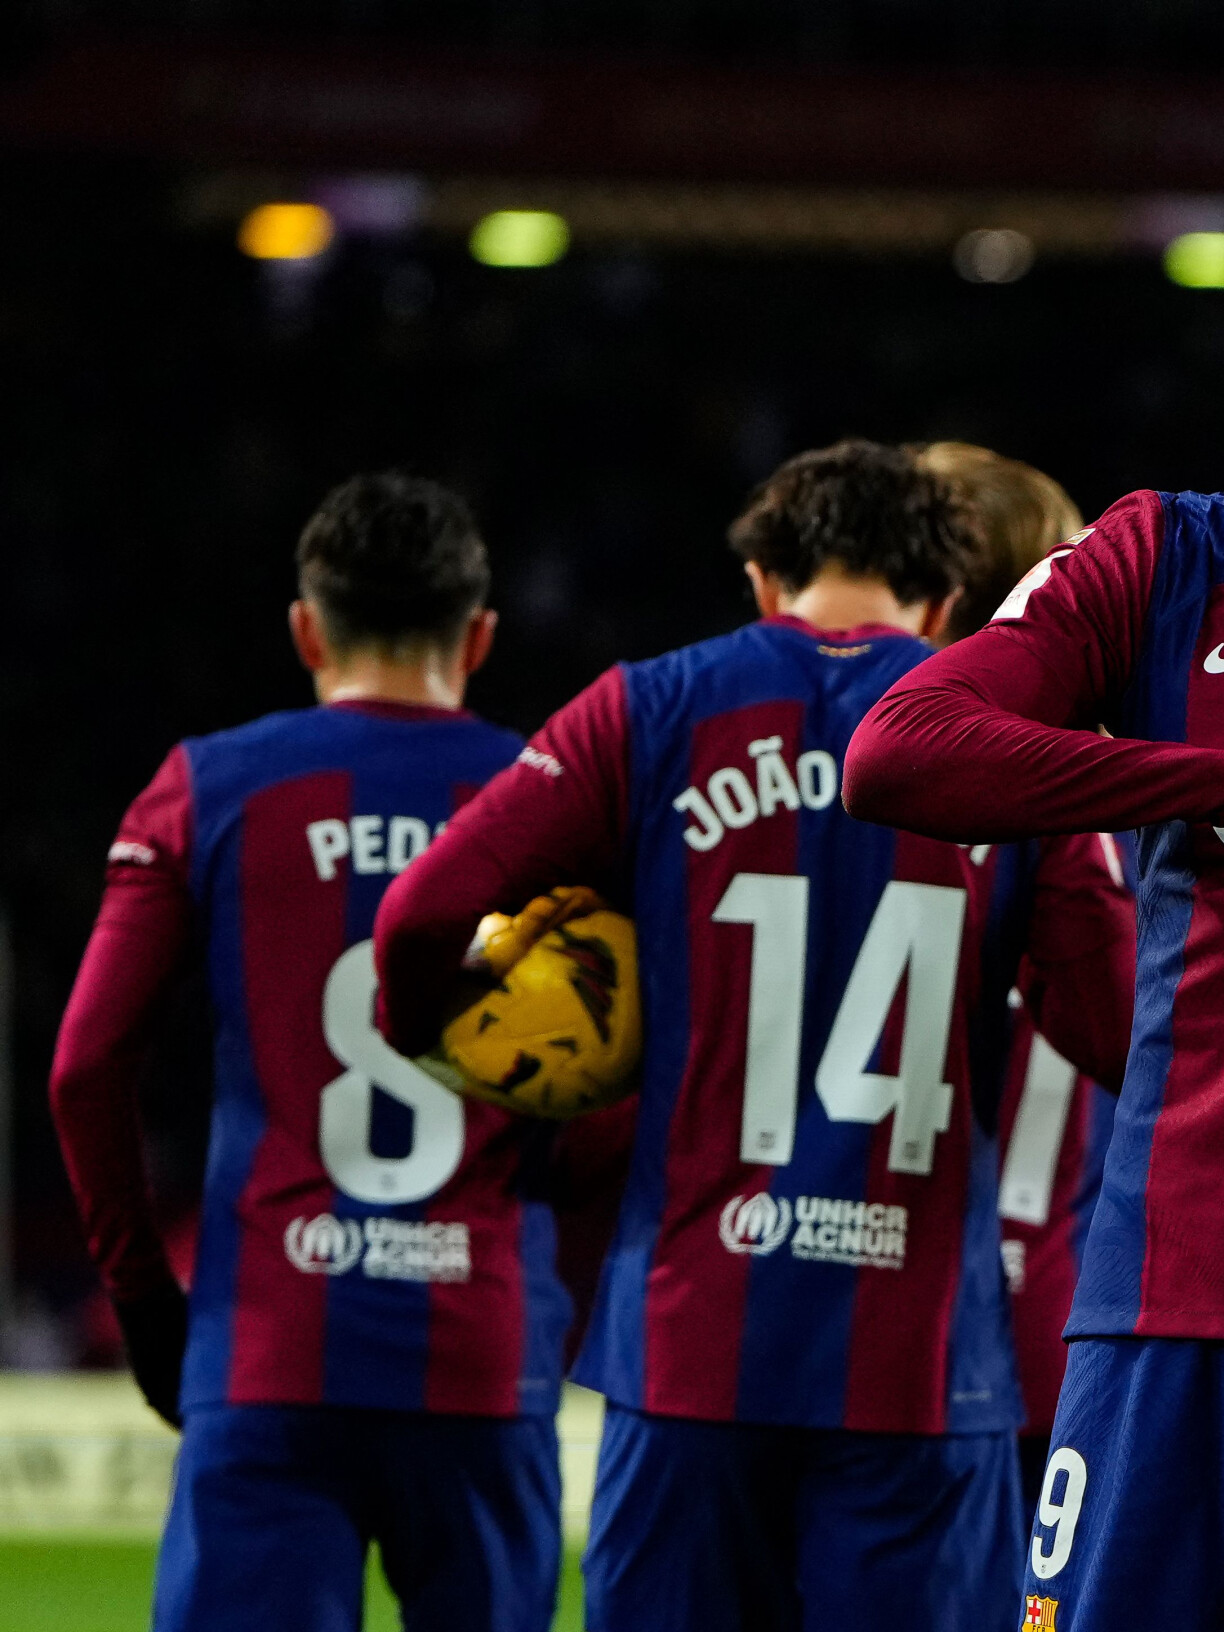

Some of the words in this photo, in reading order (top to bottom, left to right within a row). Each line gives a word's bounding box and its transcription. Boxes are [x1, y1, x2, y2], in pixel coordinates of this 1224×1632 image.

[305, 814, 447, 882] PED
[673, 735, 837, 852] JOÃO
[319, 939, 466, 1204] 8
[712, 872, 968, 1176] 14
[790, 1222, 906, 1256] ACNUR
[795, 1195, 908, 1230] UNHCR
[1031, 1446, 1087, 1579] 9
